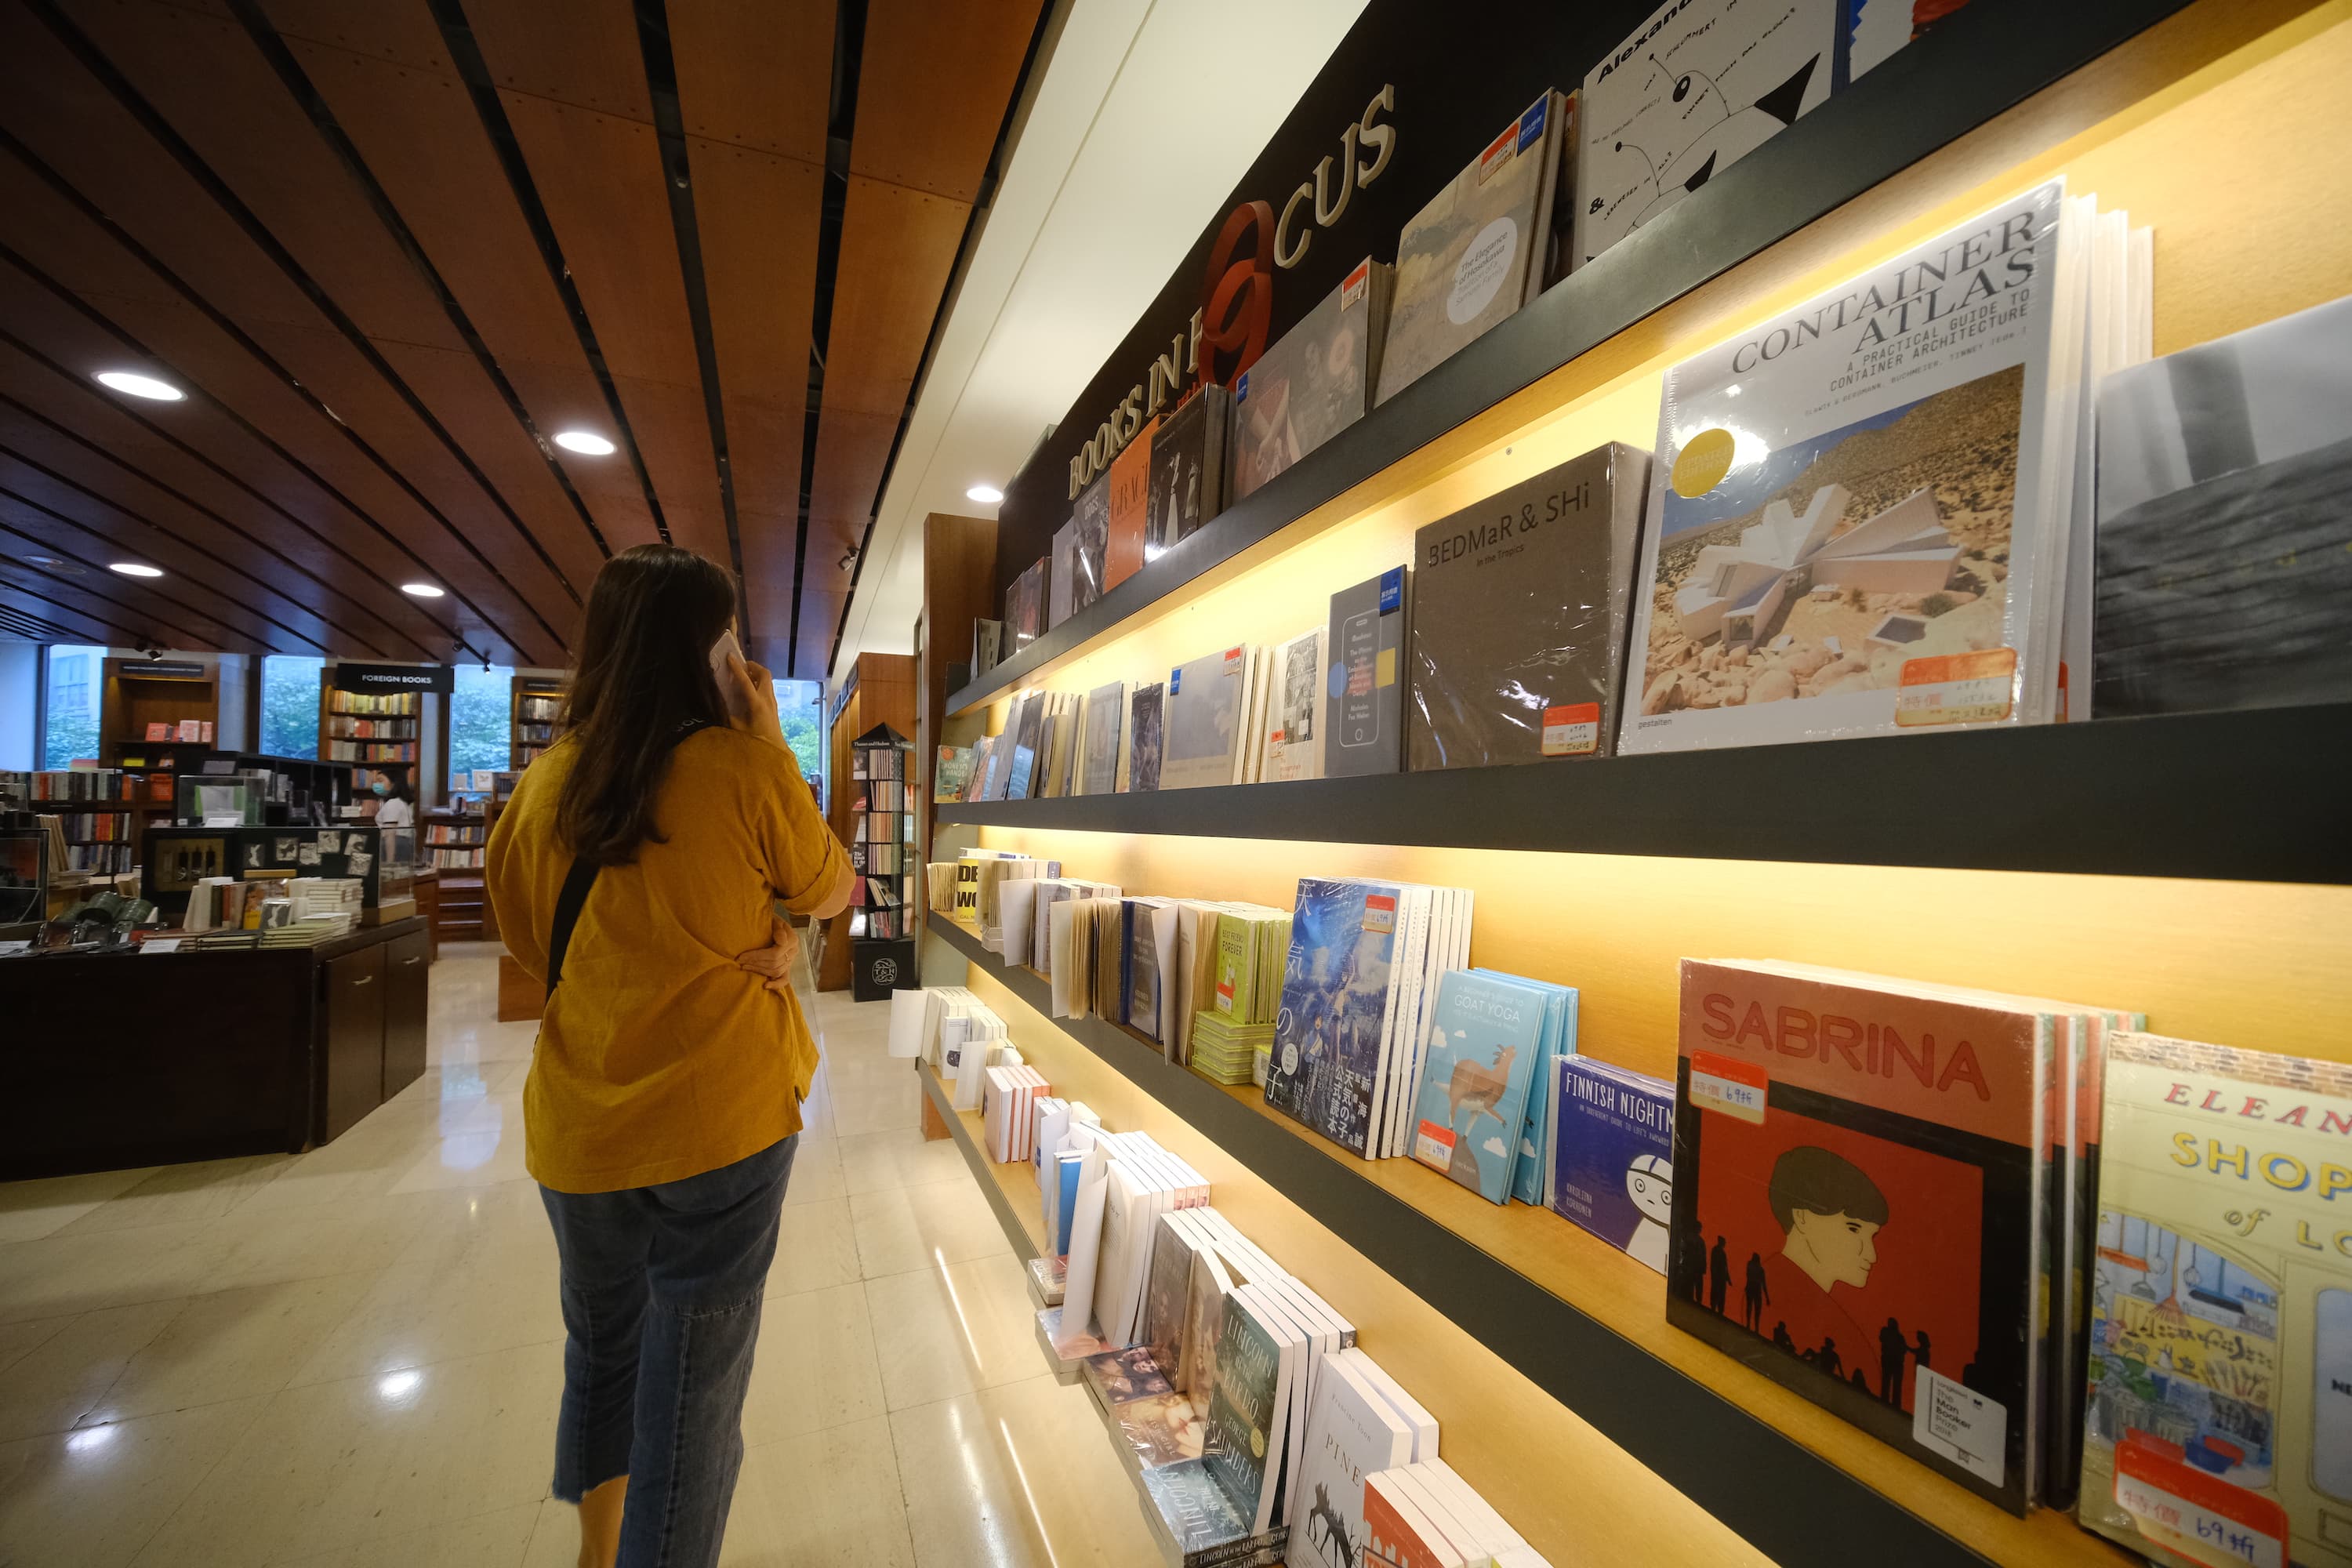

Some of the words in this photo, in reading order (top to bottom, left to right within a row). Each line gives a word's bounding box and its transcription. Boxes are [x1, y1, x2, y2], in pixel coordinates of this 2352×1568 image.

[1589, 197, 1605, 215] &
[1475, 231, 1508, 262] Elegance
[1732, 211, 2038, 374] CONTAINER
[1851, 245, 2037, 354] ATLAS
[1831, 354, 1904, 392] CONTAINER
[1913, 303, 2028, 359] ARCHITECTURE
[1847, 361, 1854, 373] A
[1864, 325, 1940, 366] PRACTICAL
[1950, 300, 1998, 331] GUIDE
[2011, 288, 2031, 305] TO
[1068, 383, 1143, 501] BOOKS
[1145, 332, 1185, 418] IN
[1428, 514, 1512, 568] BEDMaR
[1519, 503, 1538, 533] &
[1545, 481, 1589, 523] SHi
[1497, 543, 1525, 561] Tropics
[1638, 717, 1672, 730] gestalten
[1454, 994, 1485, 1012] GOAT
[1487, 1003, 1521, 1022] YOGA
[1701, 992, 1992, 1102] SABRINA
[1338, 1069, 1355, 1139] 天気の子
[1566, 1072, 1615, 1112] FINNISH
[2223, 1208, 2271, 1237] of
[1228, 1315, 1274, 1378] LINCOLN
[1224, 1367, 1259, 1420] BARDO
[1936, 1398, 1960, 1414] Man
[1937, 1389, 1955, 1403] The
[1224, 1412, 1248, 1447] GEORGE
[1357, 1421, 1372, 1443] Toon
[1936, 1406, 1972, 1430] Booker
[1936, 1414, 1958, 1432] Prize
[1209, 1420, 1260, 1494] SAUNDERS
[1325, 1432, 1362, 1487] PINE
[1200, 1548, 1229, 1565] LINCOLN
